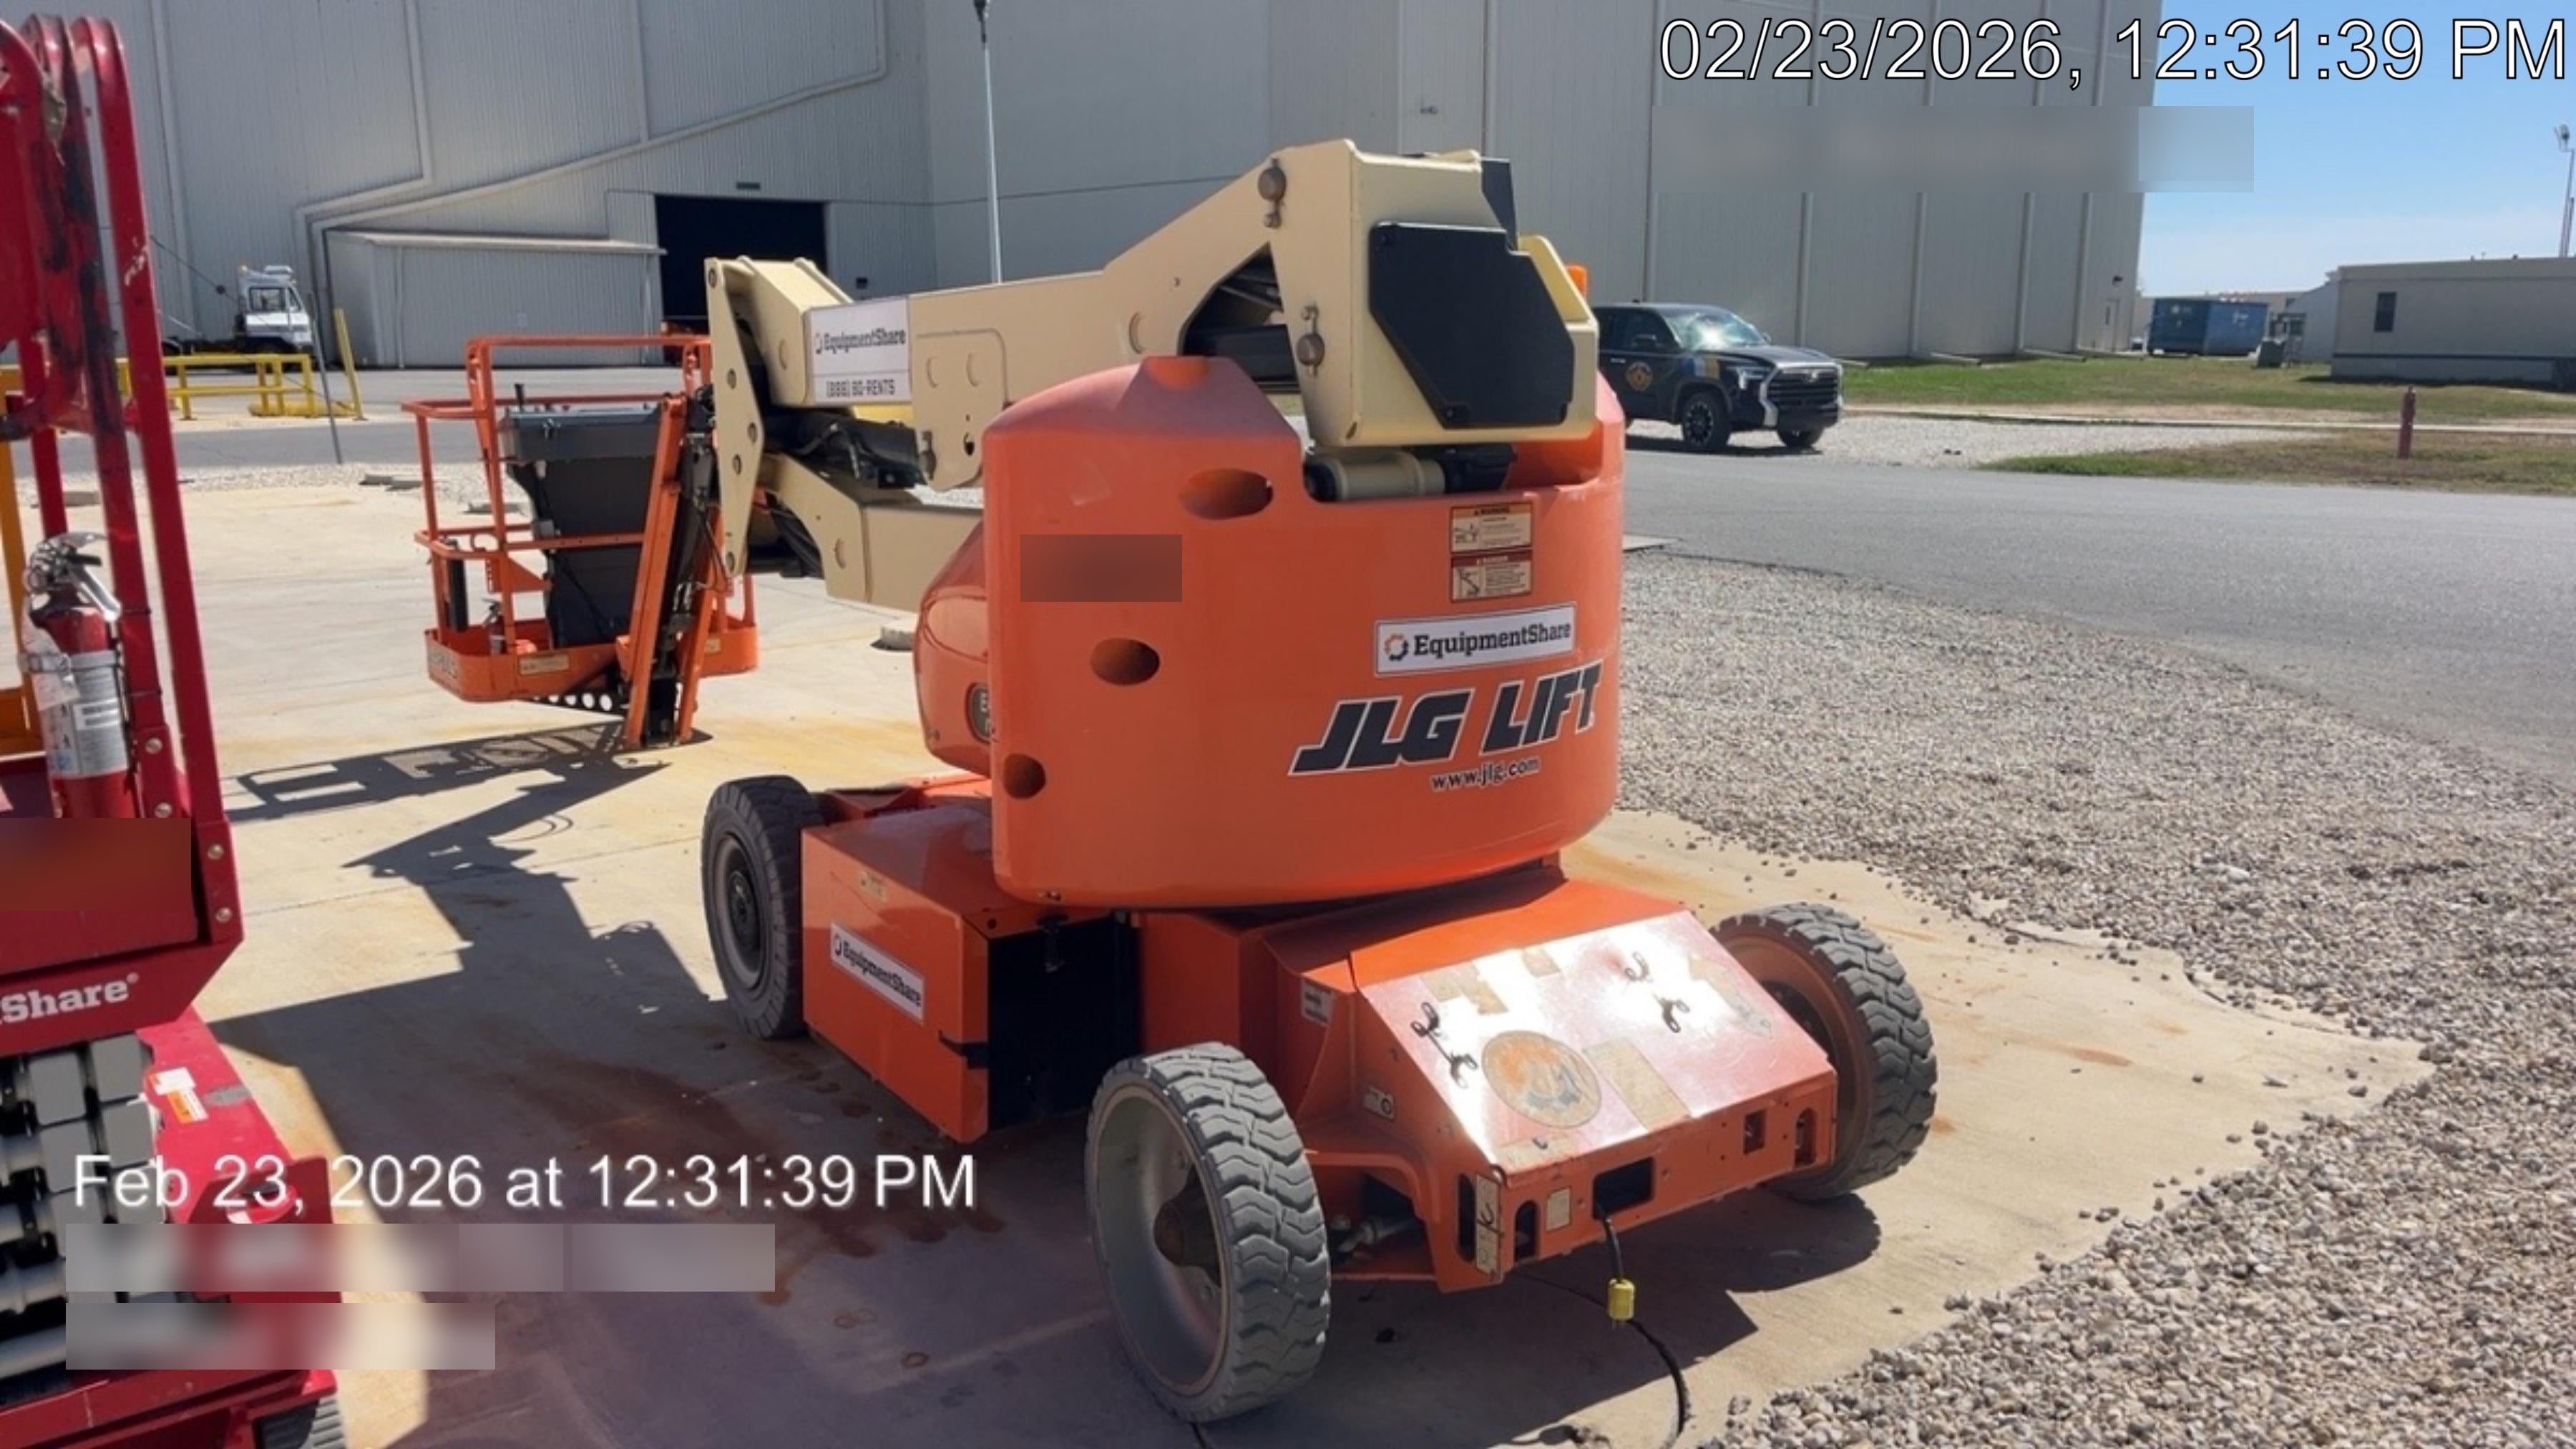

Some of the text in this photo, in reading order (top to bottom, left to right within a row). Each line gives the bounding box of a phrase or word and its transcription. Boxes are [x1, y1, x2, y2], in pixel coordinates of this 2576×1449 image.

[1413, 622, 1571, 658] EquipmentShare
[1288, 659, 1603, 776] JLG LIFT
[1432, 757, 1540, 791] www.jlg.com
